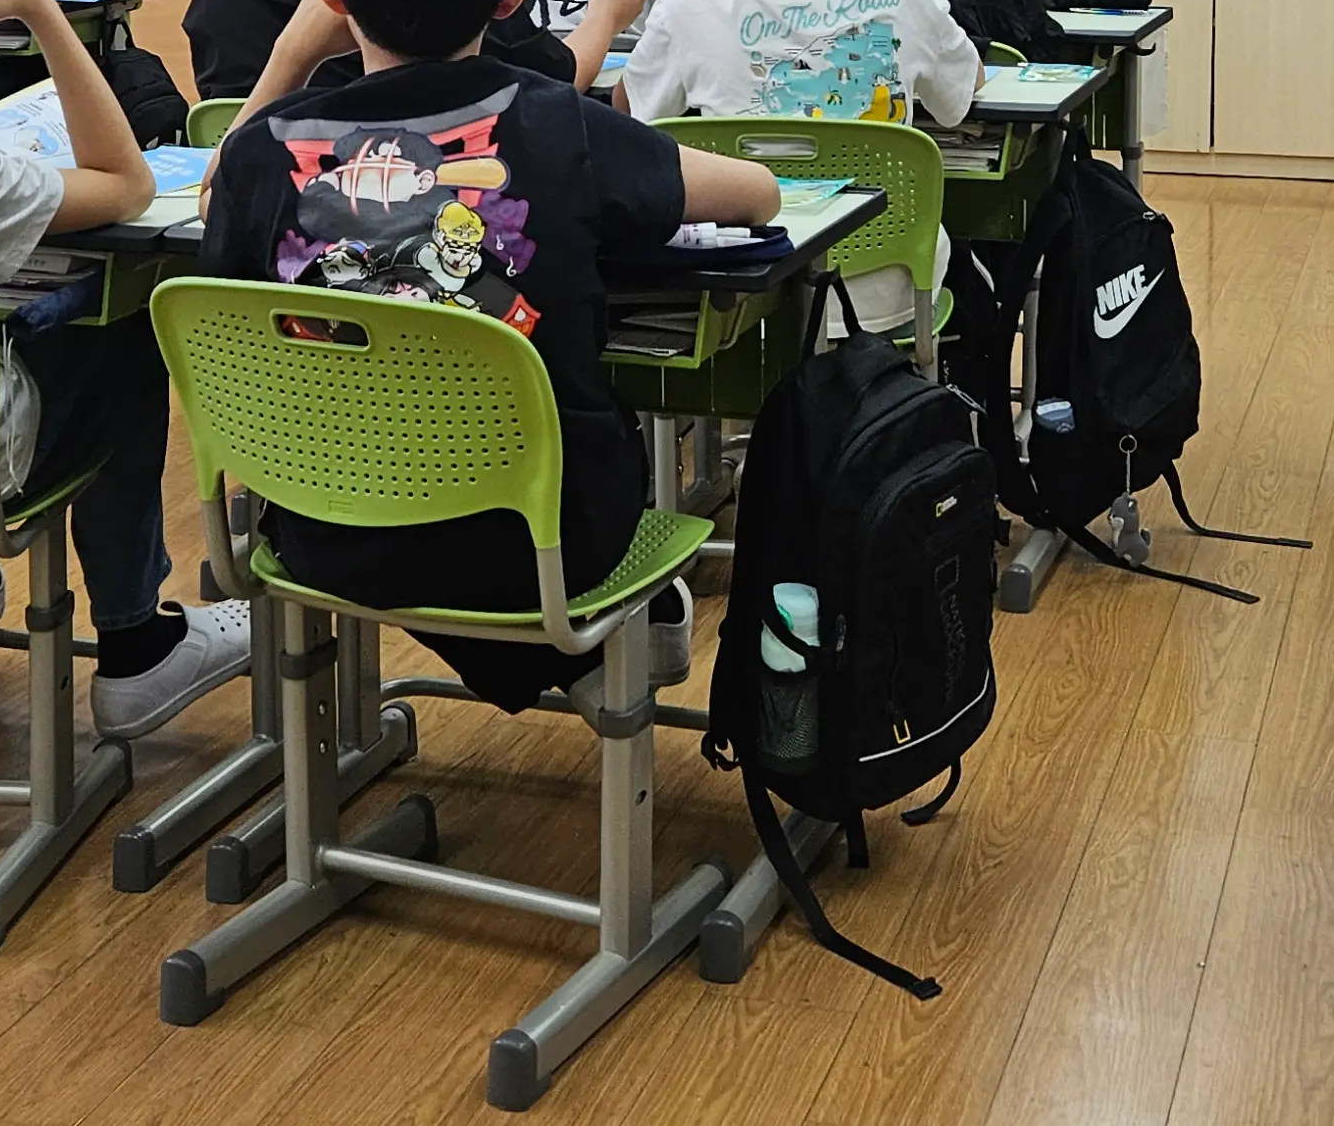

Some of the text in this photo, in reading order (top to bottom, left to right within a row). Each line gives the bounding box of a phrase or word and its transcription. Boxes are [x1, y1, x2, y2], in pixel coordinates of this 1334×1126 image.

[740, 11, 782, 47] On
[781, 1, 822, 40] The
[1095, 263, 1148, 316] NIKE
